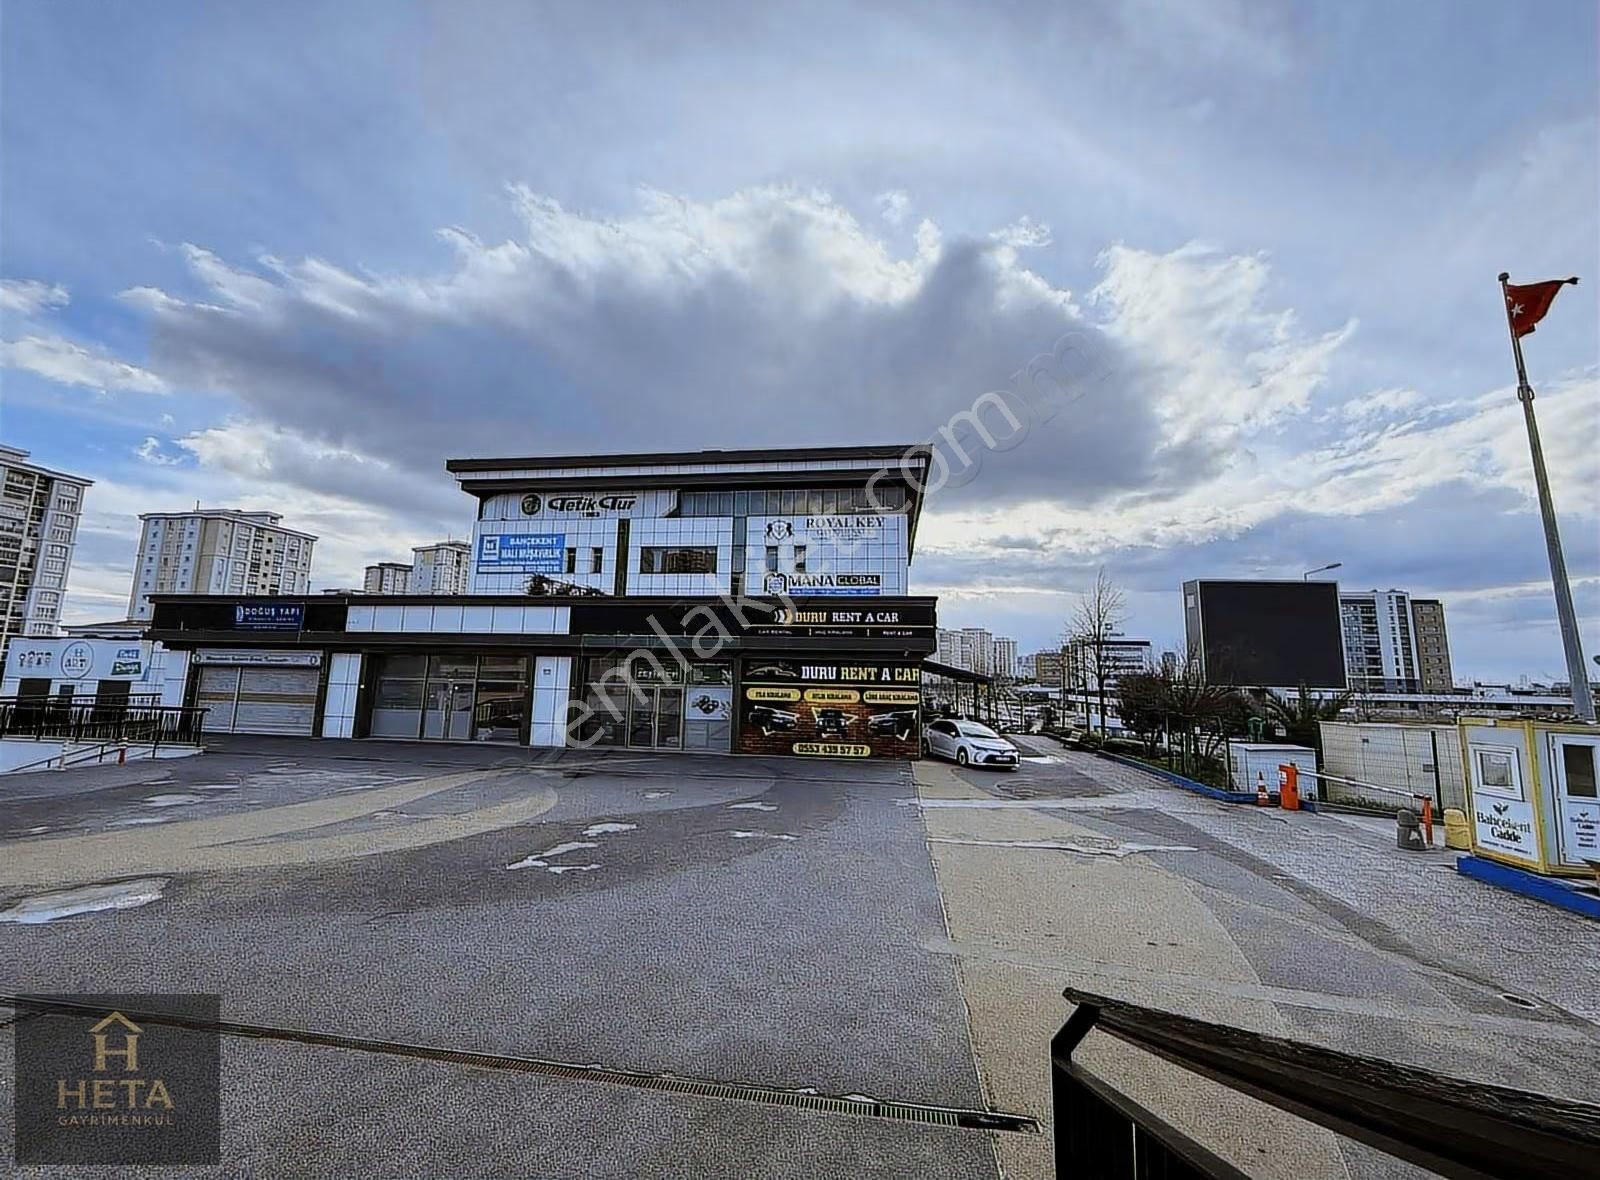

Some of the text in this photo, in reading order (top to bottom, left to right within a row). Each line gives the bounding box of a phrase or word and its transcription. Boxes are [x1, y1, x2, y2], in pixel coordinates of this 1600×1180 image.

[548, 495, 637, 511] Tetik Tur
[806, 516, 883, 528] ROYAL KEY
[788, 575, 878, 587] MANA GLOBAL
[795, 612, 899, 622] DURU RENT A CAR
[801, 666, 920, 682] DURU RENT A CAR
[840, 745, 851, 755] 57
[853, 746, 865, 755] 57
[1491, 826, 1522, 844] Cadde
